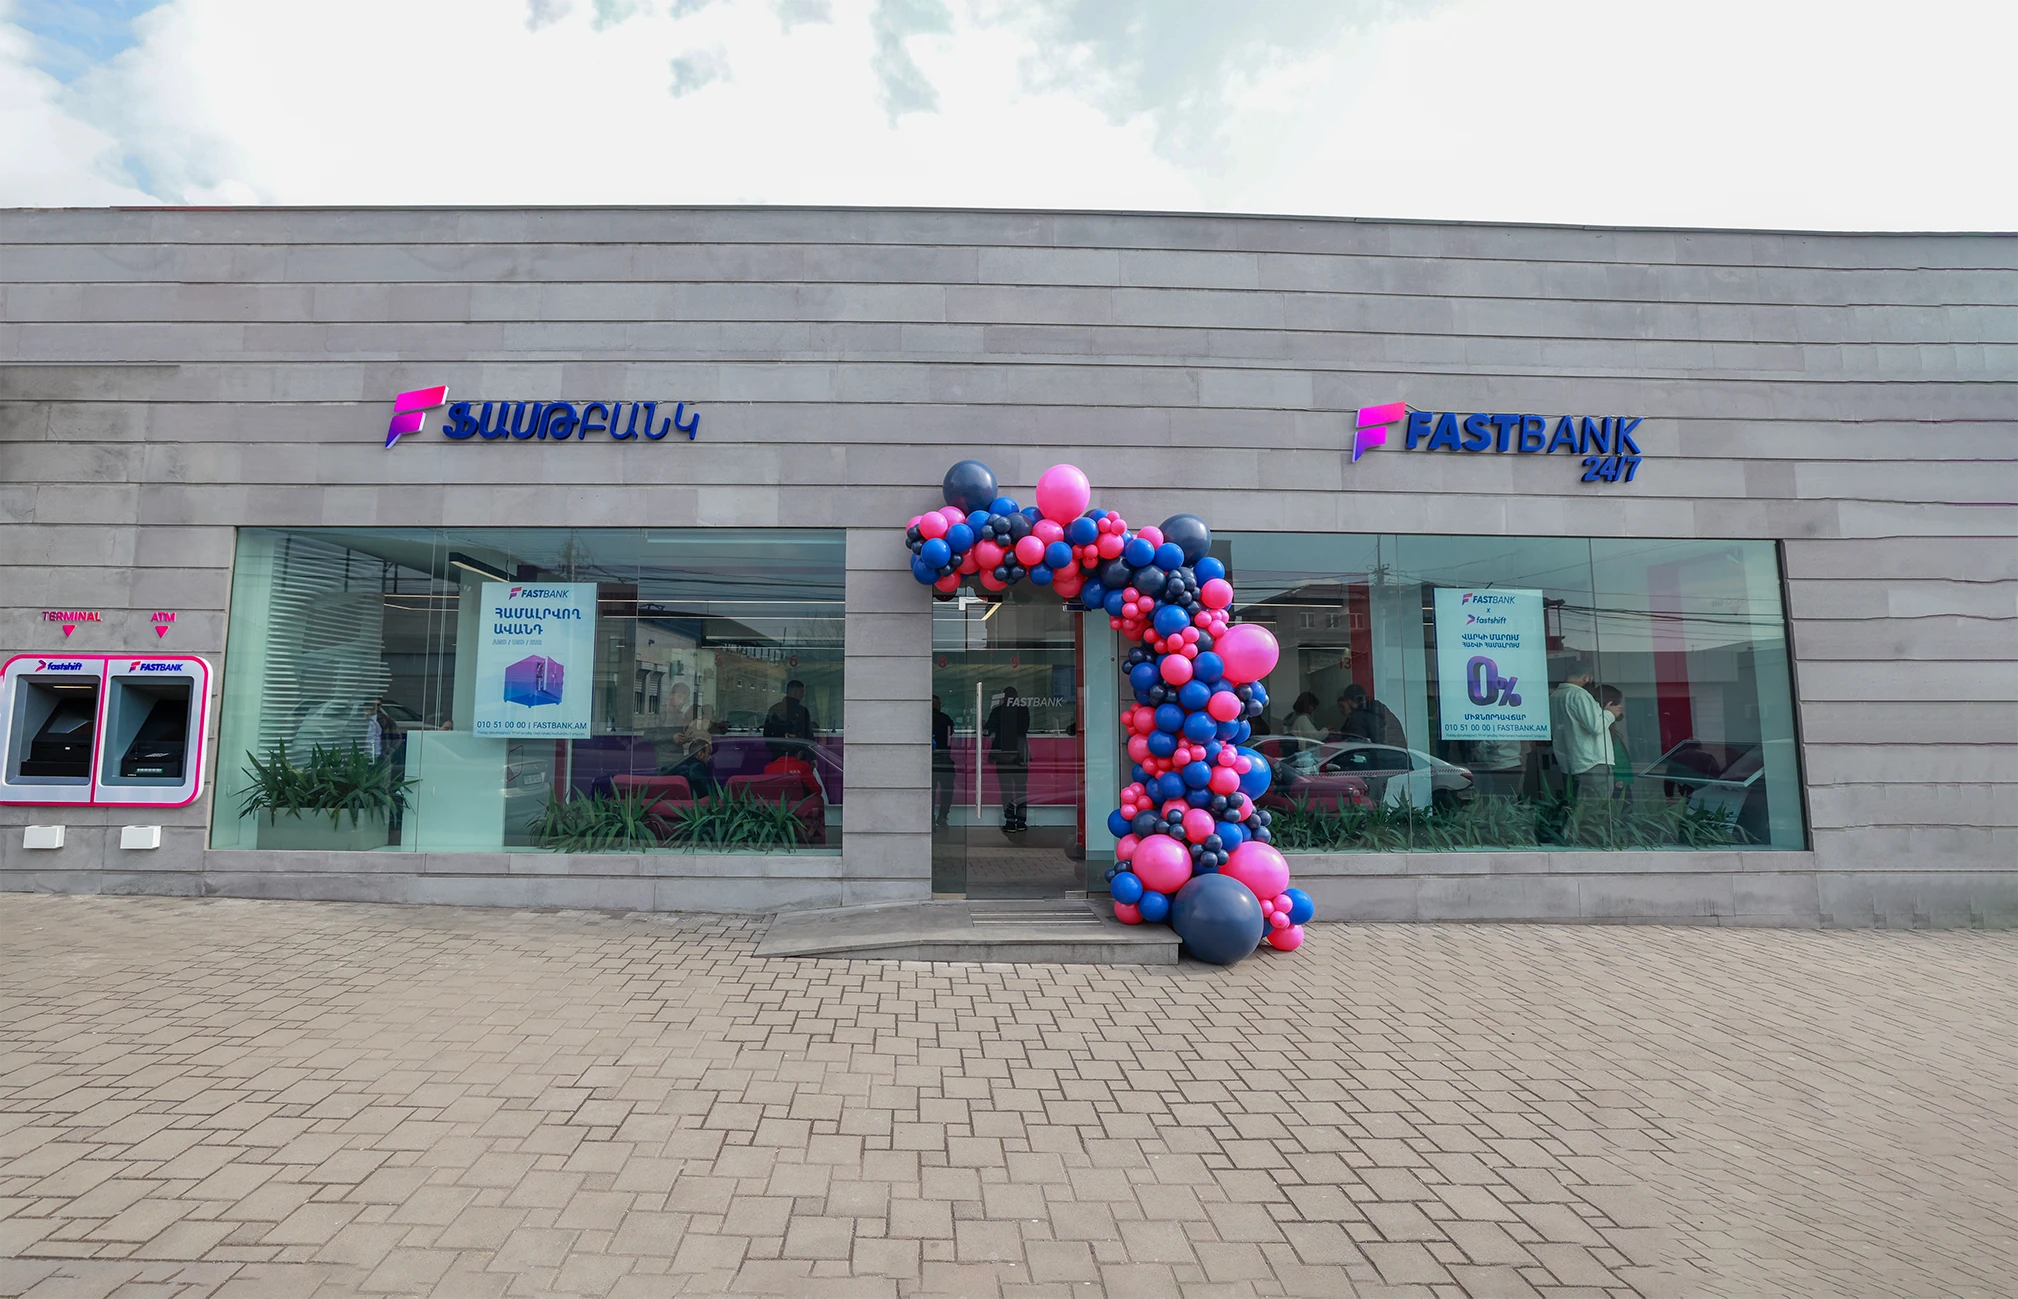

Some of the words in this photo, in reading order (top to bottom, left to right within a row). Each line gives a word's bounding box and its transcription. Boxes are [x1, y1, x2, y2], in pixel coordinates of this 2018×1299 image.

[442, 401, 700, 441] ՖԱՍԹԲԱՆԿ
[1405, 411, 1644, 455] FASTBANK
[1581, 455, 1643, 482] 24/7
[521, 589, 570, 599] FASTBANK
[1472, 595, 1516, 604] FASTBANK
[42, 611, 102, 622] TERMINAL
[150, 612, 176, 623] ATM
[494, 606, 581, 621] ՀԱՄԱԼՐՎՈՂ
[1476, 615, 1507, 624] fastshift
[494, 623, 543, 635] ԱՎԱՆԴ
[47, 661, 83, 671] fastshift
[140, 663, 183, 672] FASTBANK
[938, 656, 947, 669] 8
[1011, 656, 1020, 669] 9
[1339, 657, 1352, 670] 13
[1466, 655, 1523, 708] 0%
[1006, 696, 1064, 707] FASTBANK
[476, 720, 491, 729] 010
[493, 720, 502, 729] 51
[504, 721, 514, 729] 00
[516, 721, 526, 729] 00
[533, 721, 587, 730] FASTBANK.AM
[1444, 723, 1458, 731] 010
[1460, 723, 1468, 731] 51
[1470, 723, 1480, 731] 00
[1481, 723, 1491, 731] 00
[1497, 724, 1548, 732] FASTBANK.AM
